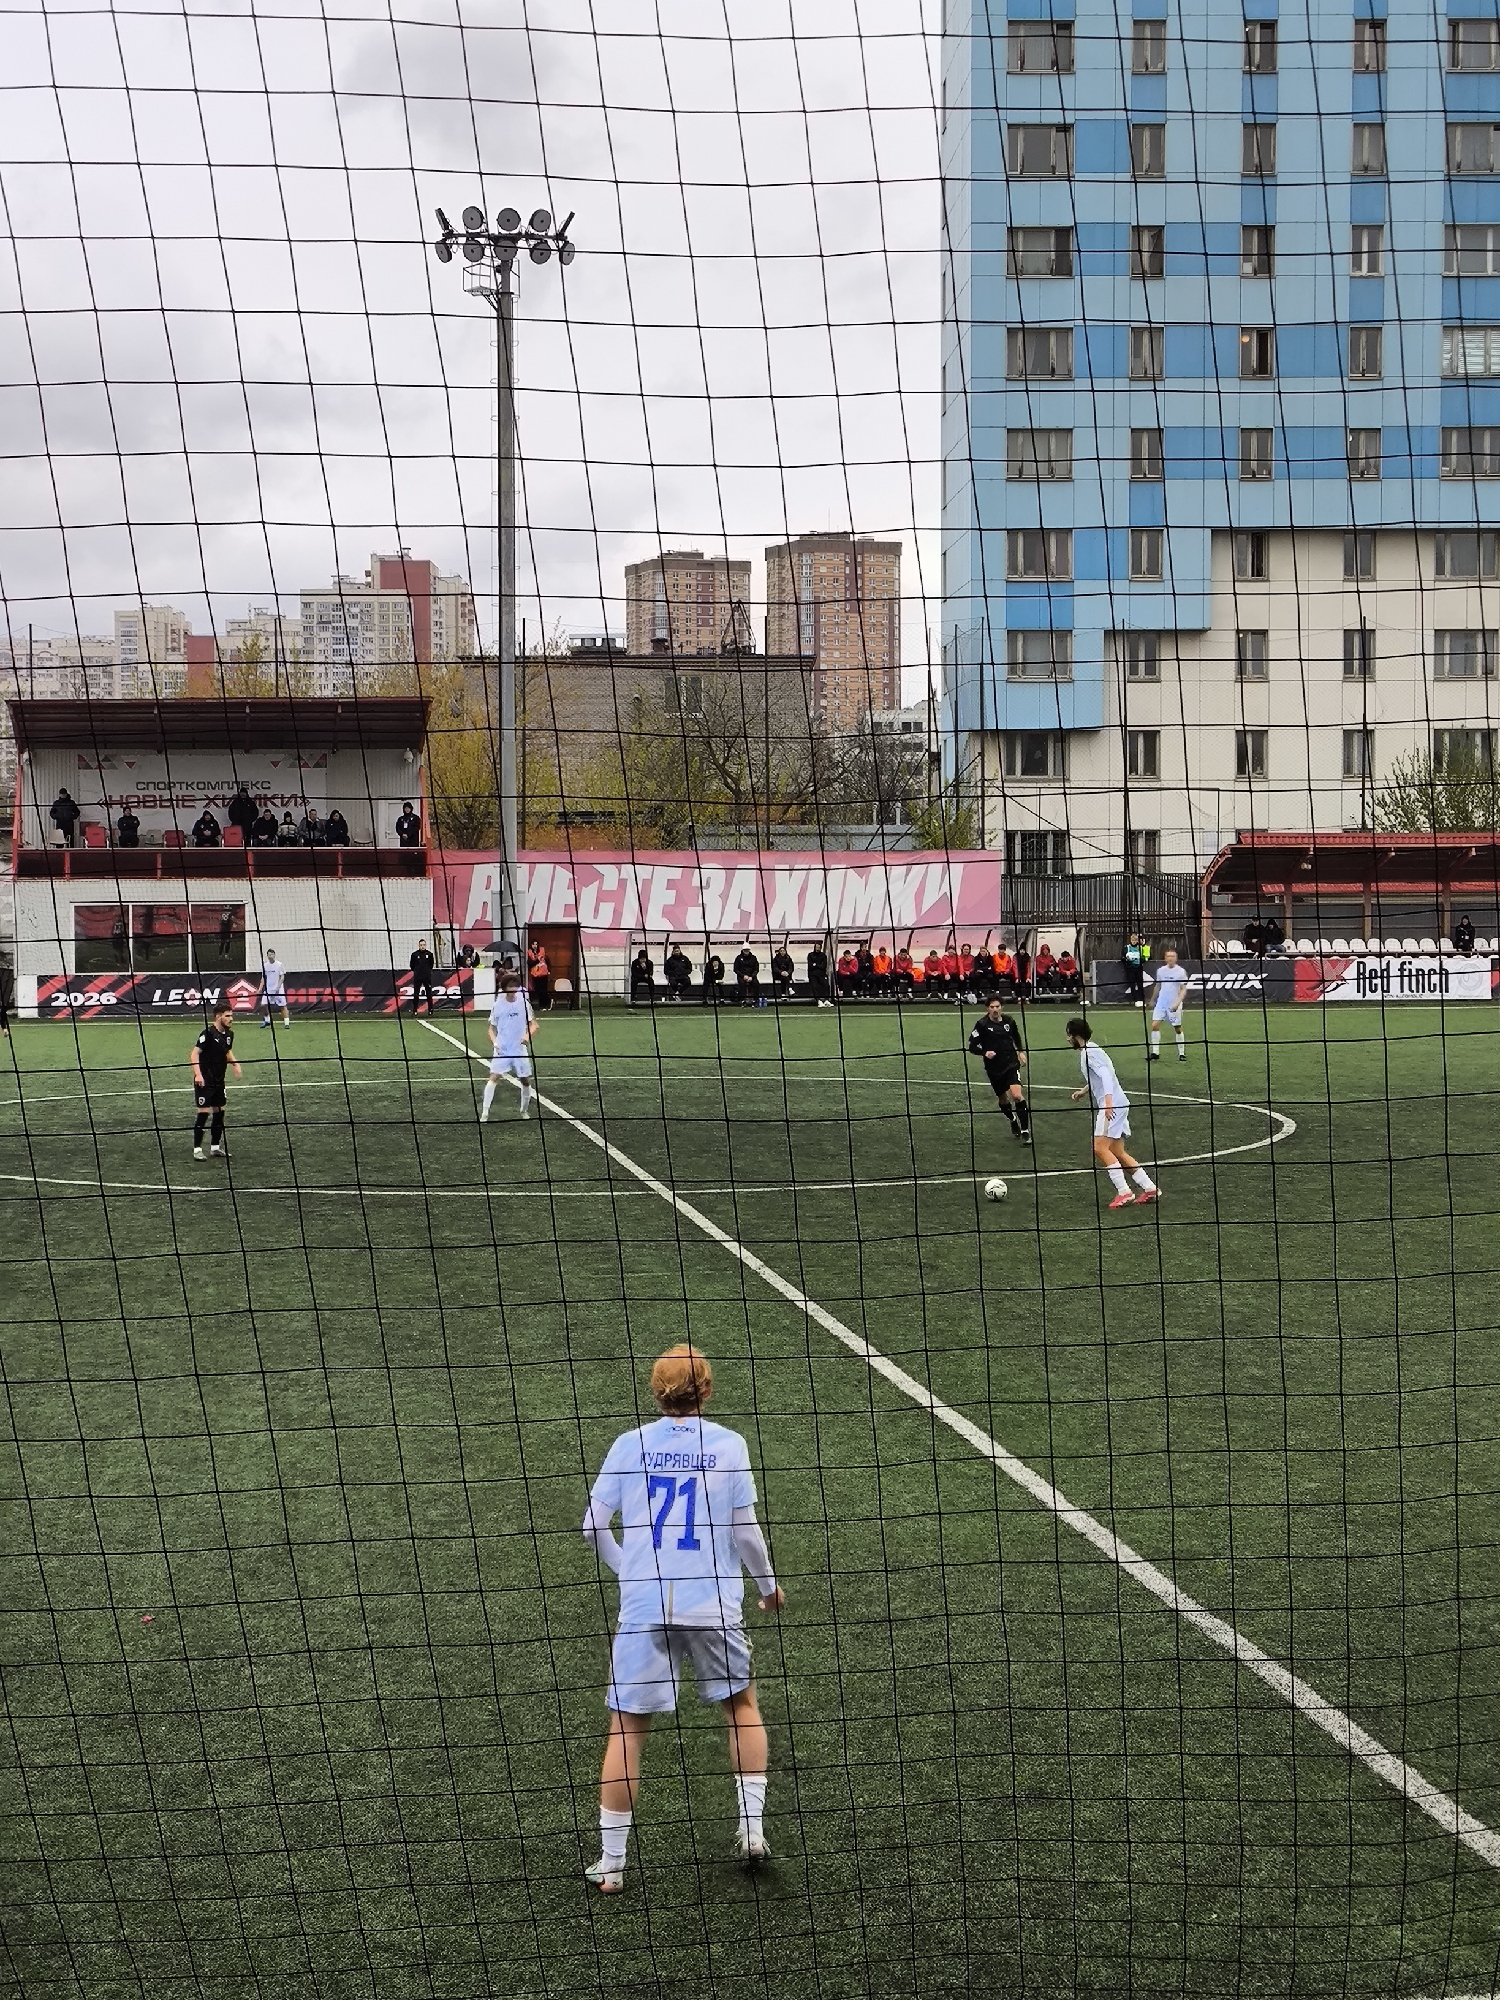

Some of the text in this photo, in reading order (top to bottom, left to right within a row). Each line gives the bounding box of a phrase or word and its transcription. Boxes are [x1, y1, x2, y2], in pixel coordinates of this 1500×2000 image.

[136, 780, 271, 791] СПОРТКОМПЛЕКС
[686, 863, 757, 932] ЗА
[768, 862, 964, 931] ХИМКИ
[1182, 973, 1268, 990] EMIX
[1357, 960, 1450, 999] Red finch
[51, 992, 118, 1007] 2026
[151, 988, 221, 1006] LEON
[285, 987, 342, 1004] ИГА
[345, 987, 365, 1002] Б
[640, 1452, 717, 1470] КУДРЯВЦЕВ
[649, 1475, 701, 1551] 71
